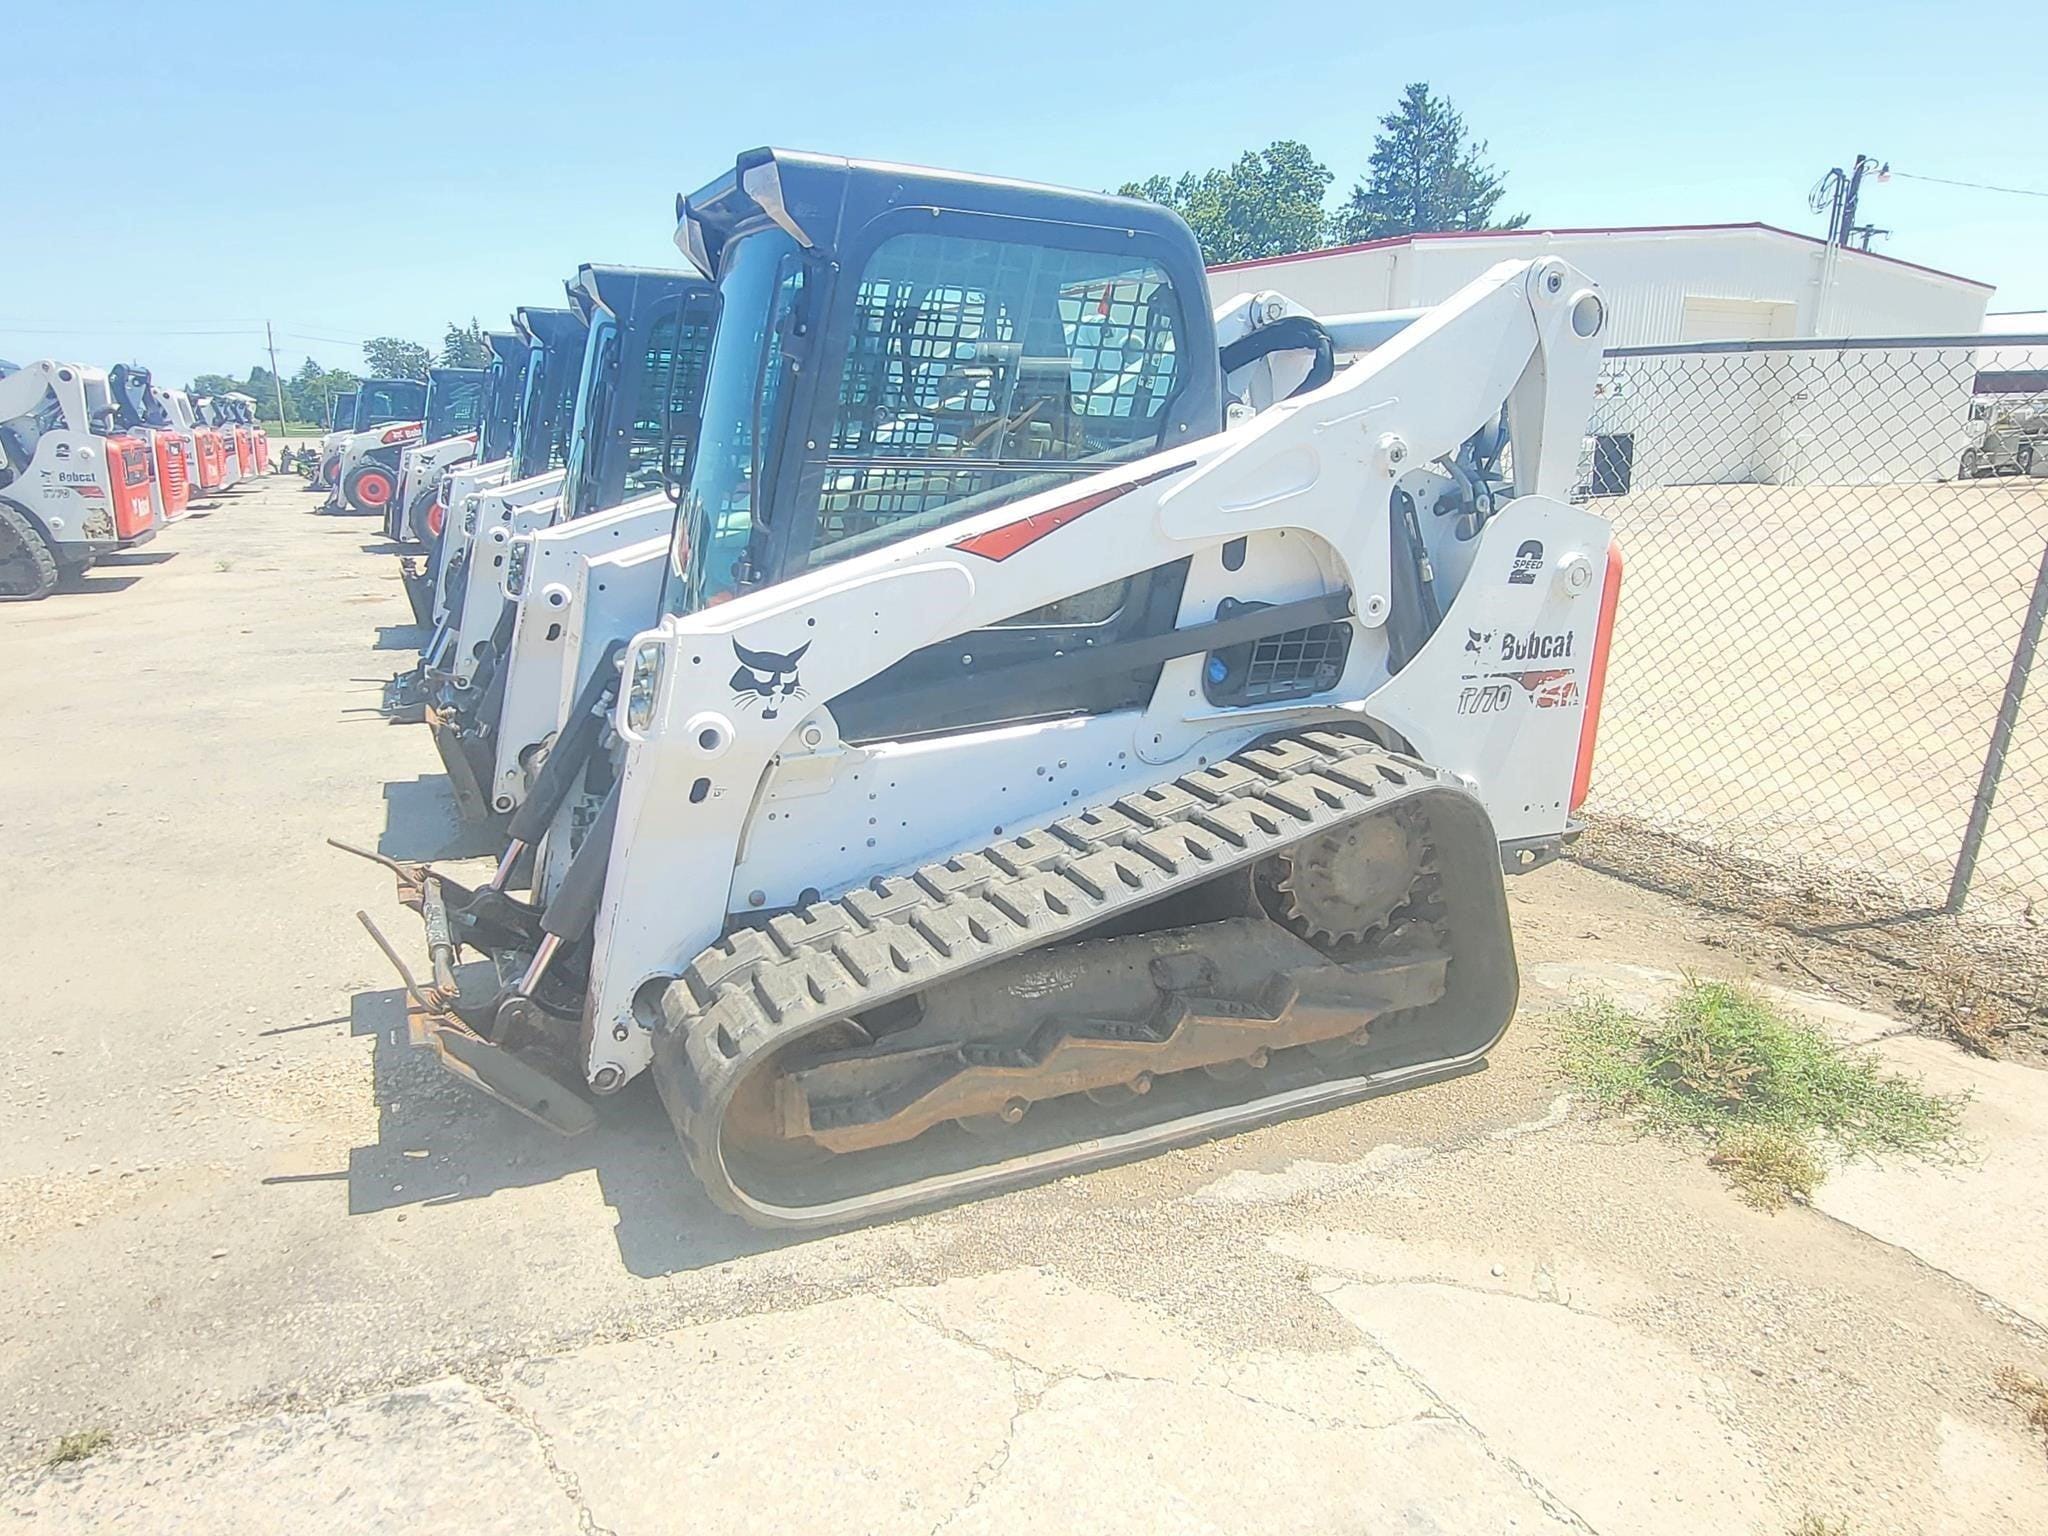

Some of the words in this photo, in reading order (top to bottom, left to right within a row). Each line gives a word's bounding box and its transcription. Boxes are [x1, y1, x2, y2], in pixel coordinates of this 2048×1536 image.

[59, 472, 96, 482] Bobcat
[1512, 559, 1544, 569] SPEED
[1501, 631, 1574, 661] Bobcat
